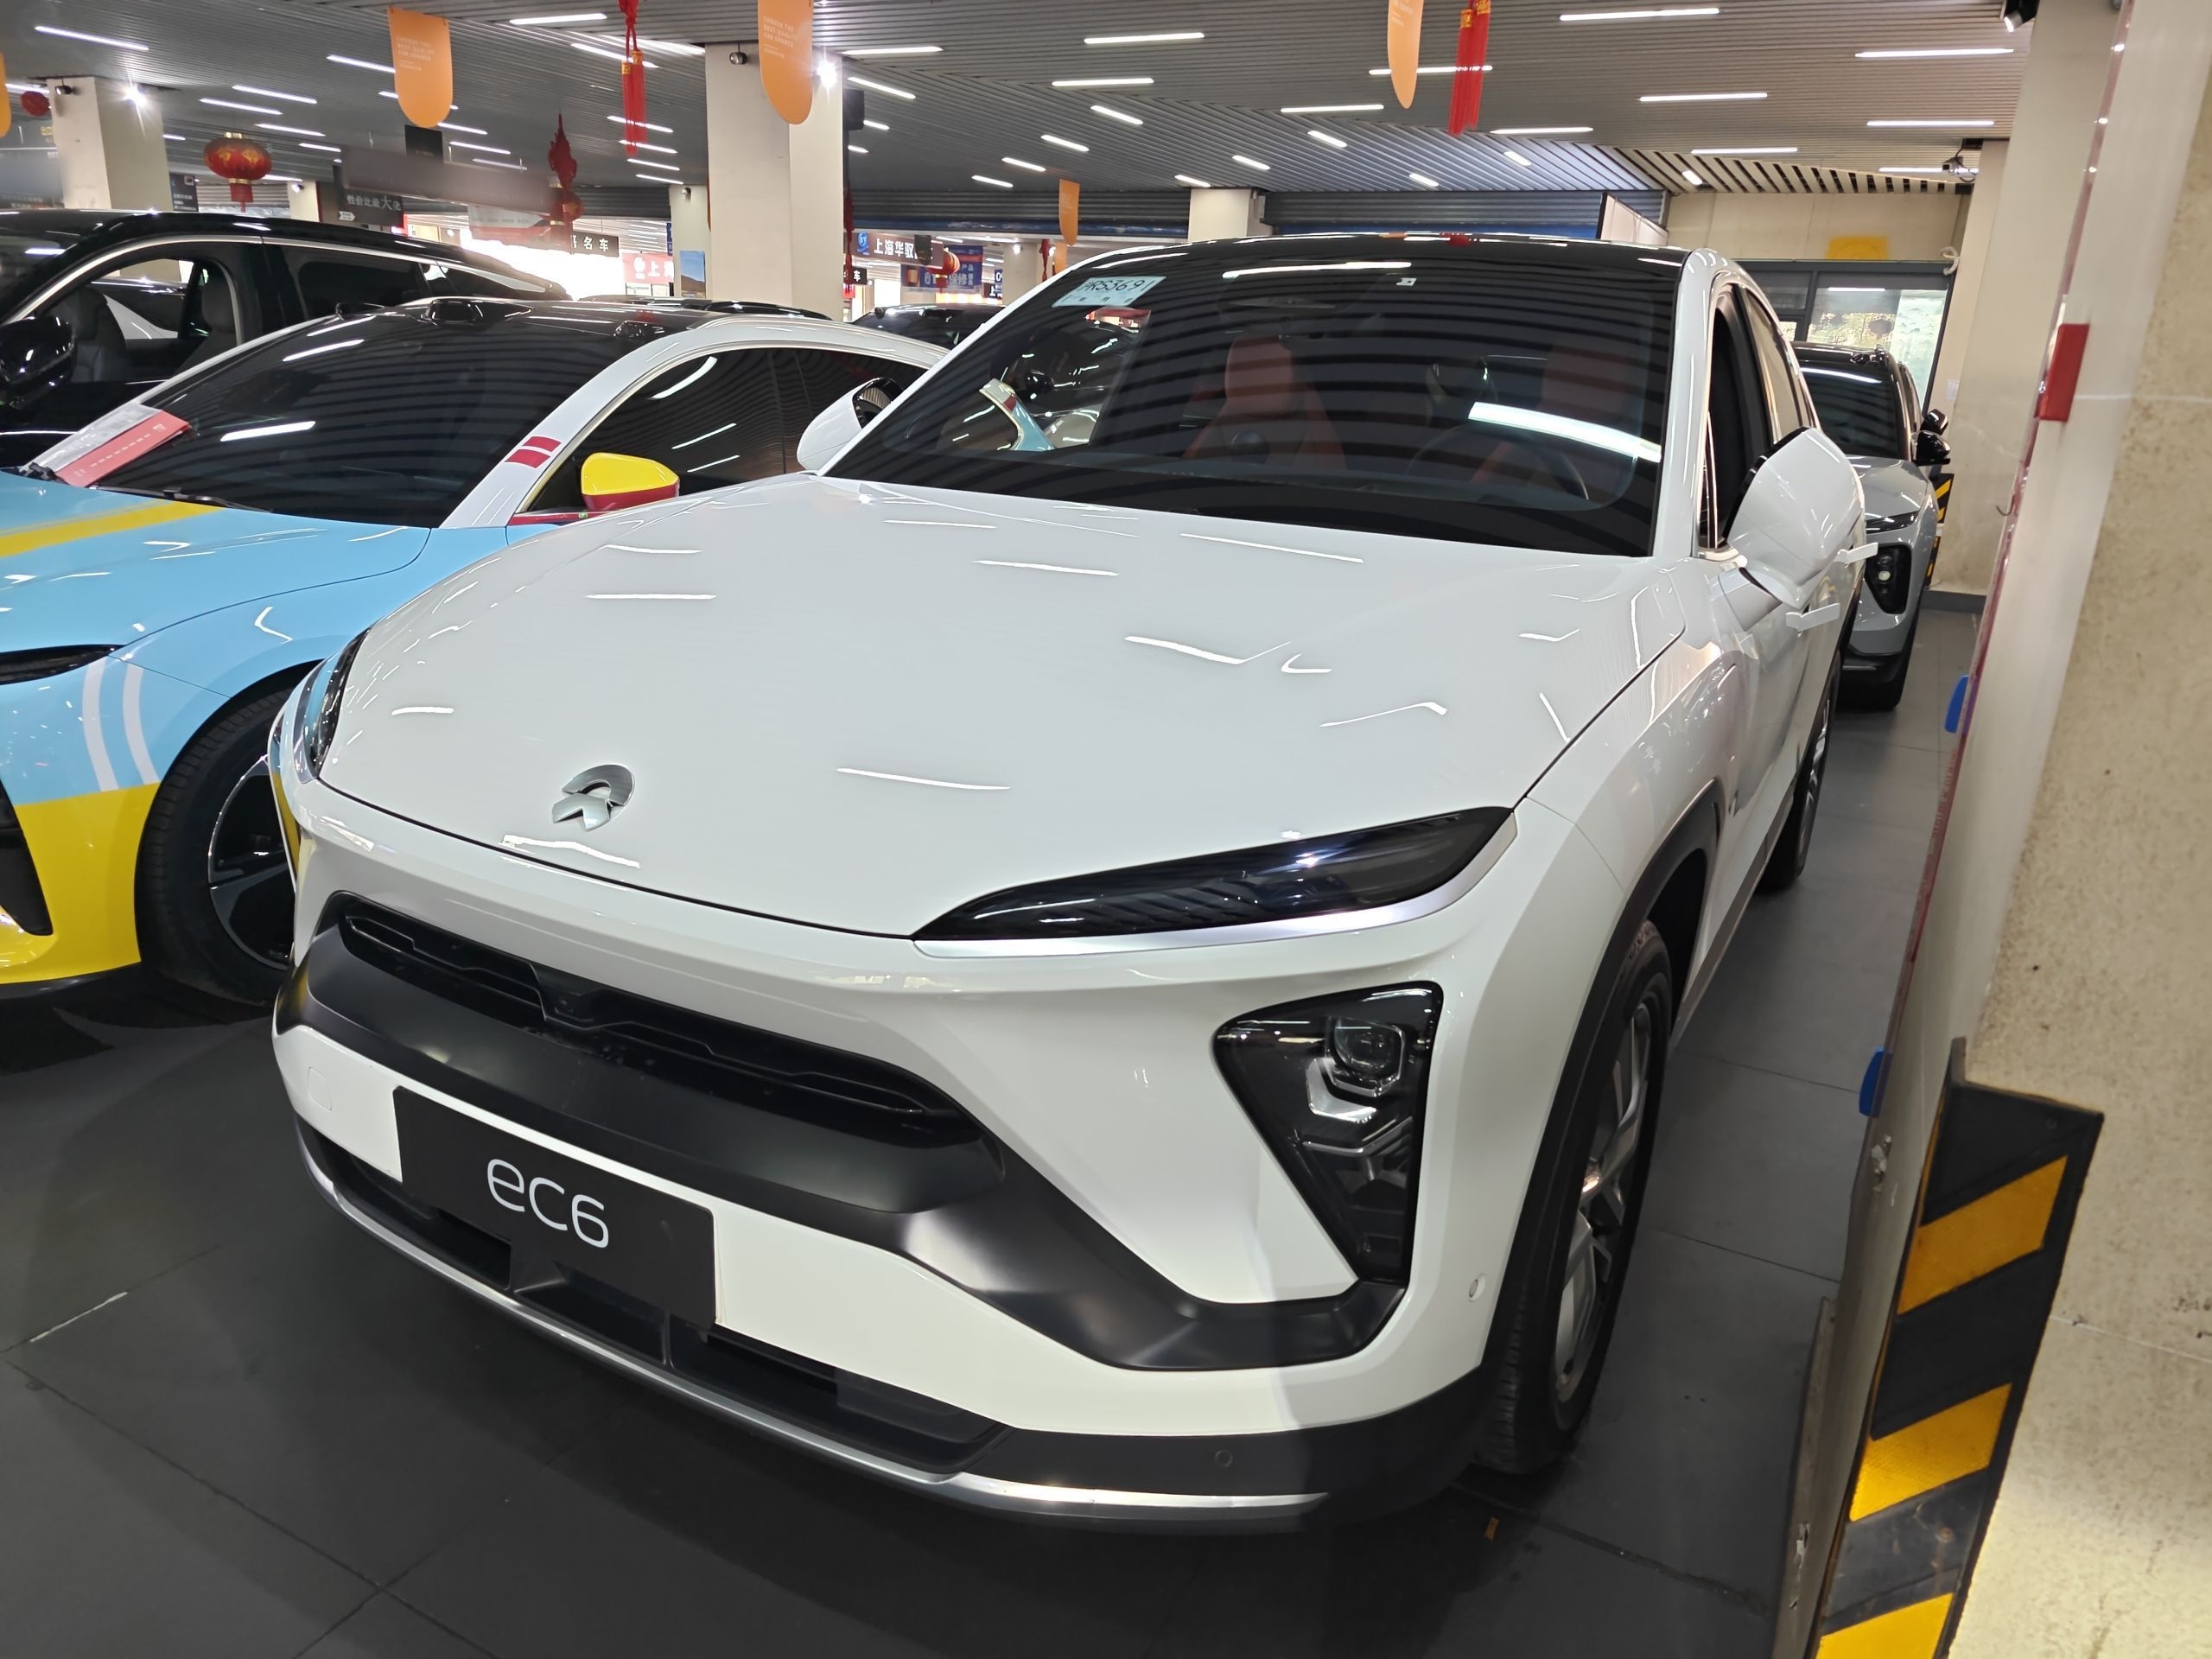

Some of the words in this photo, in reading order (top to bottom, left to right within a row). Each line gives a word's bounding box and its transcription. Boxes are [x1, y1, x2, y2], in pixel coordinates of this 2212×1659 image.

[346, 194, 401, 211] 性价比最大化
